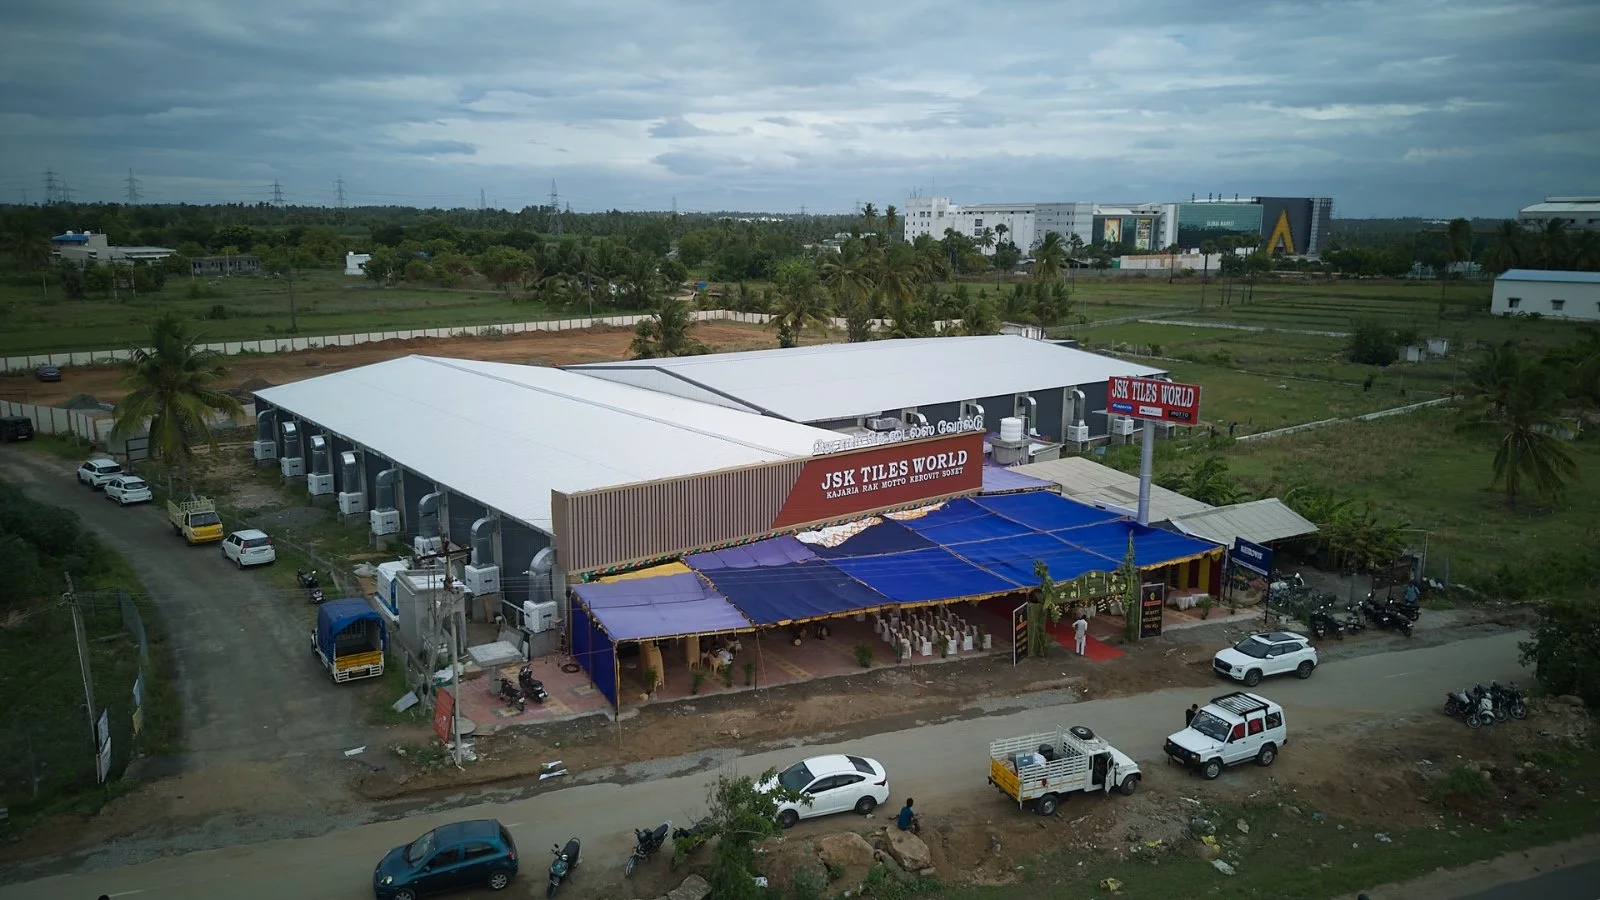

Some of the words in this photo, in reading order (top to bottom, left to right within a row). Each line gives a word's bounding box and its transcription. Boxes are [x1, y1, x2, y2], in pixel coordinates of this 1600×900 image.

[1112, 379, 1129, 399] JSK
[1131, 381, 1158, 404] TILES
[1161, 384, 1194, 408] WORLD
[821, 468, 856, 490] JSK
[860, 460, 909, 483] TILES
[912, 450, 968, 473] WORLD
[826, 487, 859, 500] KAJARIA
[862, 483, 879, 493] RAK
[881, 477, 907, 489] MOTTO
[909, 472, 940, 484] KEROVIT
[942, 466, 964, 478] SONET
